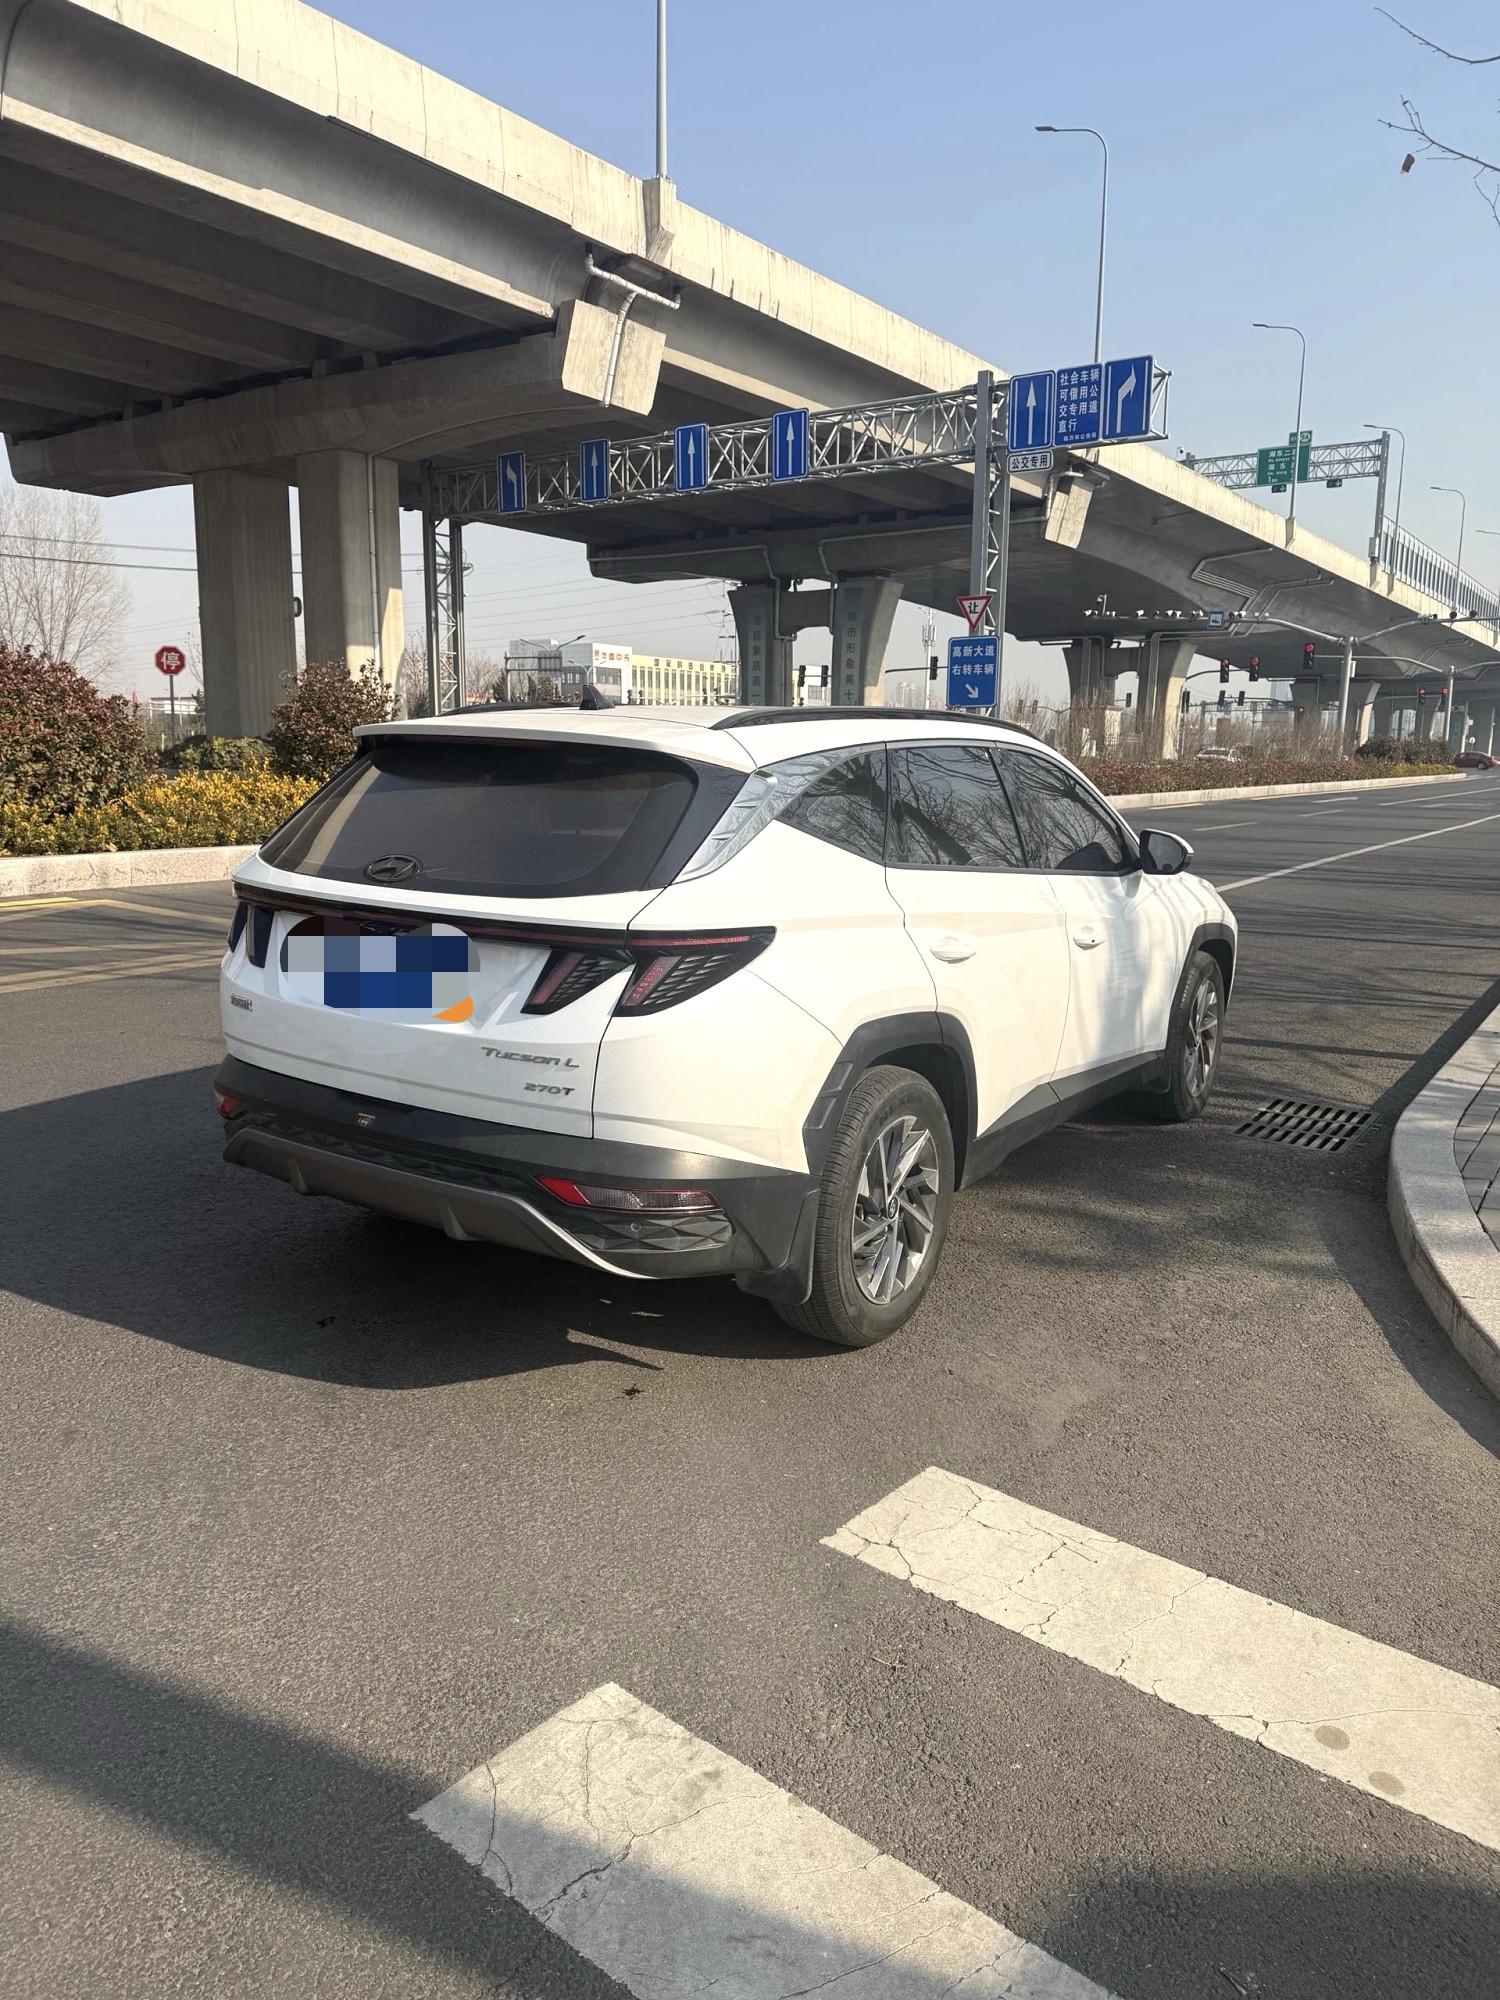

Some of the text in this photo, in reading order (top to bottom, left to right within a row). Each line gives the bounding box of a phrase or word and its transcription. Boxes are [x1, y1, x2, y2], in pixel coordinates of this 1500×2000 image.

[1060, 368, 1100, 387] 社会车辆
[1059, 384, 1099, 402] 可借用公
[1059, 400, 1098, 418] 交专用道
[1057, 418, 1077, 434] 直行
[1011, 454, 1048, 469] 公交专用
[968, 601, 979, 614] 让
[844, 610, 858, 705] 城市形象美十
[952, 645, 995, 657] 高新大道
[161, 652, 180, 670] 停
[952, 663, 995, 676] 右转车辆
[564, 1058, 580, 1068] L
[524, 1082, 575, 1096] 270T
